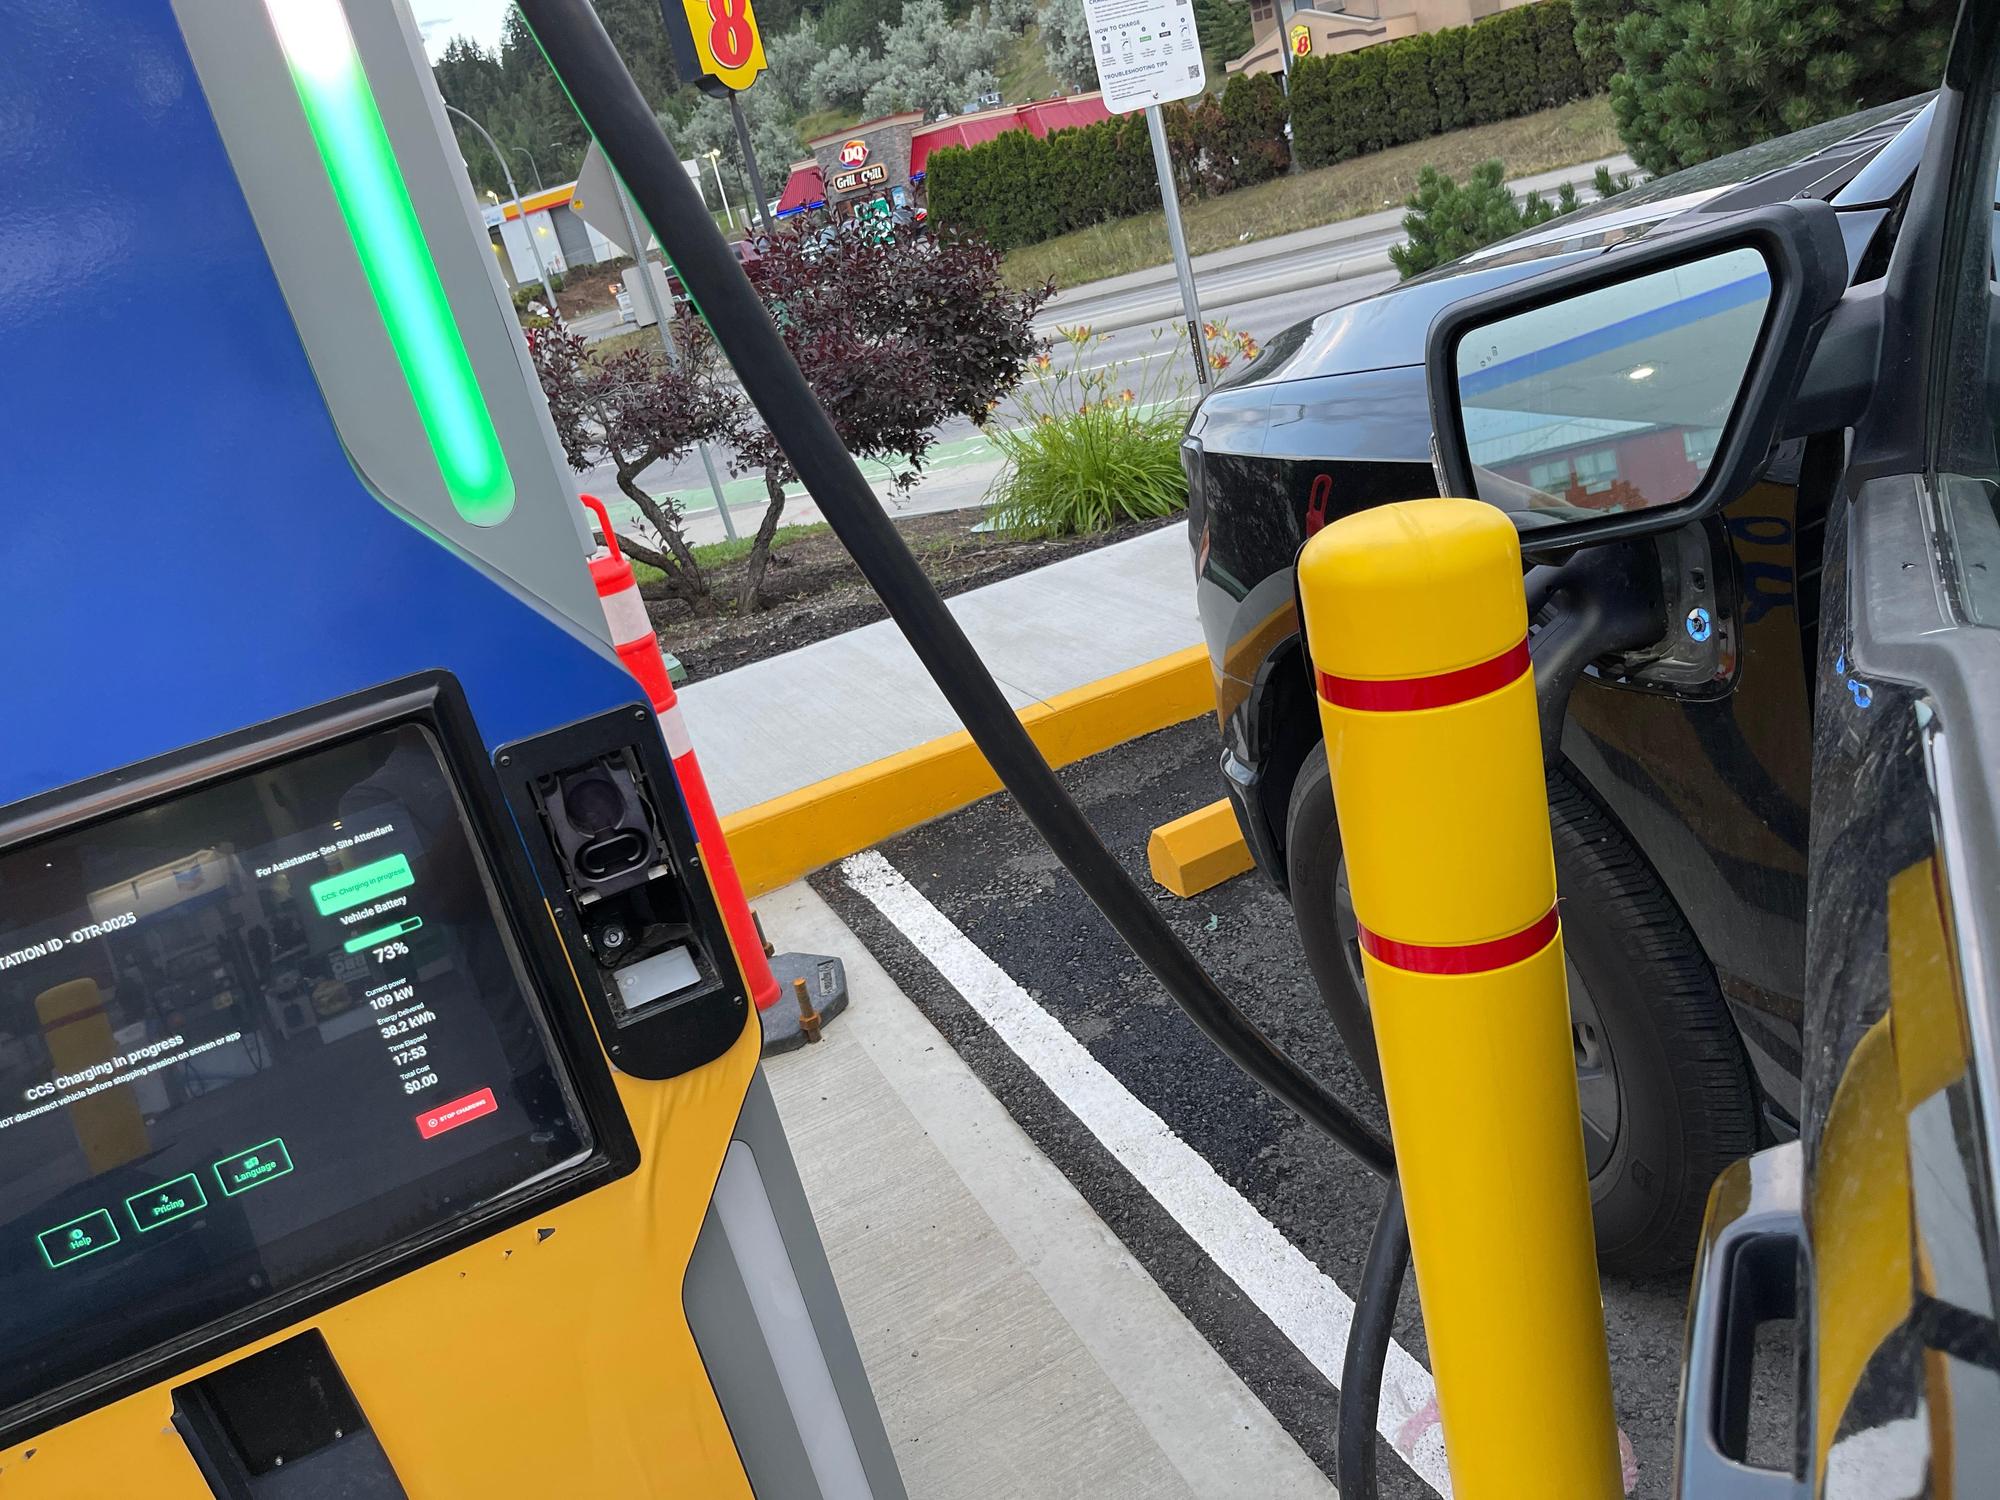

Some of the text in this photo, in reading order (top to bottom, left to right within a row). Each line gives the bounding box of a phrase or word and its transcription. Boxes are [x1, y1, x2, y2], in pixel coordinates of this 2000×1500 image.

[707, 0, 753, 70] 8
[844, 146, 863, 163] DQ
[837, 174, 856, 188] Grill
[861, 167, 882, 182] Chill
[256, 825, 394, 878] For Assistance: See Site Attendant
[339, 880, 369, 896] Charging
[377, 867, 406, 883] progress
[340, 896, 407, 925] Vehicle Battery
[47, 938, 64, 952] ID
[72, 912, 136, 943] OTR-0025
[372, 942, 409, 963] 73%
[366, 977, 407, 997] Current power
[370, 985, 414, 1010] 109 kW
[377, 1002, 425, 1026] Energy Delivered
[381, 1010, 437, 1039] 38.2 kWh
[388, 1033, 428, 1053] Time Elapsed
[393, 1045, 427, 1066] 17:53
[14, 1100, 59, 1123] disconnect
[57, 1090, 87, 1107] vehicle
[86, 1081, 113, 1097] before
[113, 1067, 148, 1087] stopping
[147, 1056, 178, 1073] session
[177, 1051, 190, 1061] on
[189, 1041, 216, 1057] screen
[216, 1037, 226, 1046] or
[225, 1031, 242, 1044] app
[26, 1035, 184, 1101] CCS Charging in progress
[400, 1064, 431, 1081] Total Cost
[404, 1072, 439, 1095] $0.00
[440, 1113, 457, 1122] STOP
[235, 1161, 276, 1182] Language
[152, 1197, 185, 1216] Pricing
[70, 1235, 92, 1250] Help
